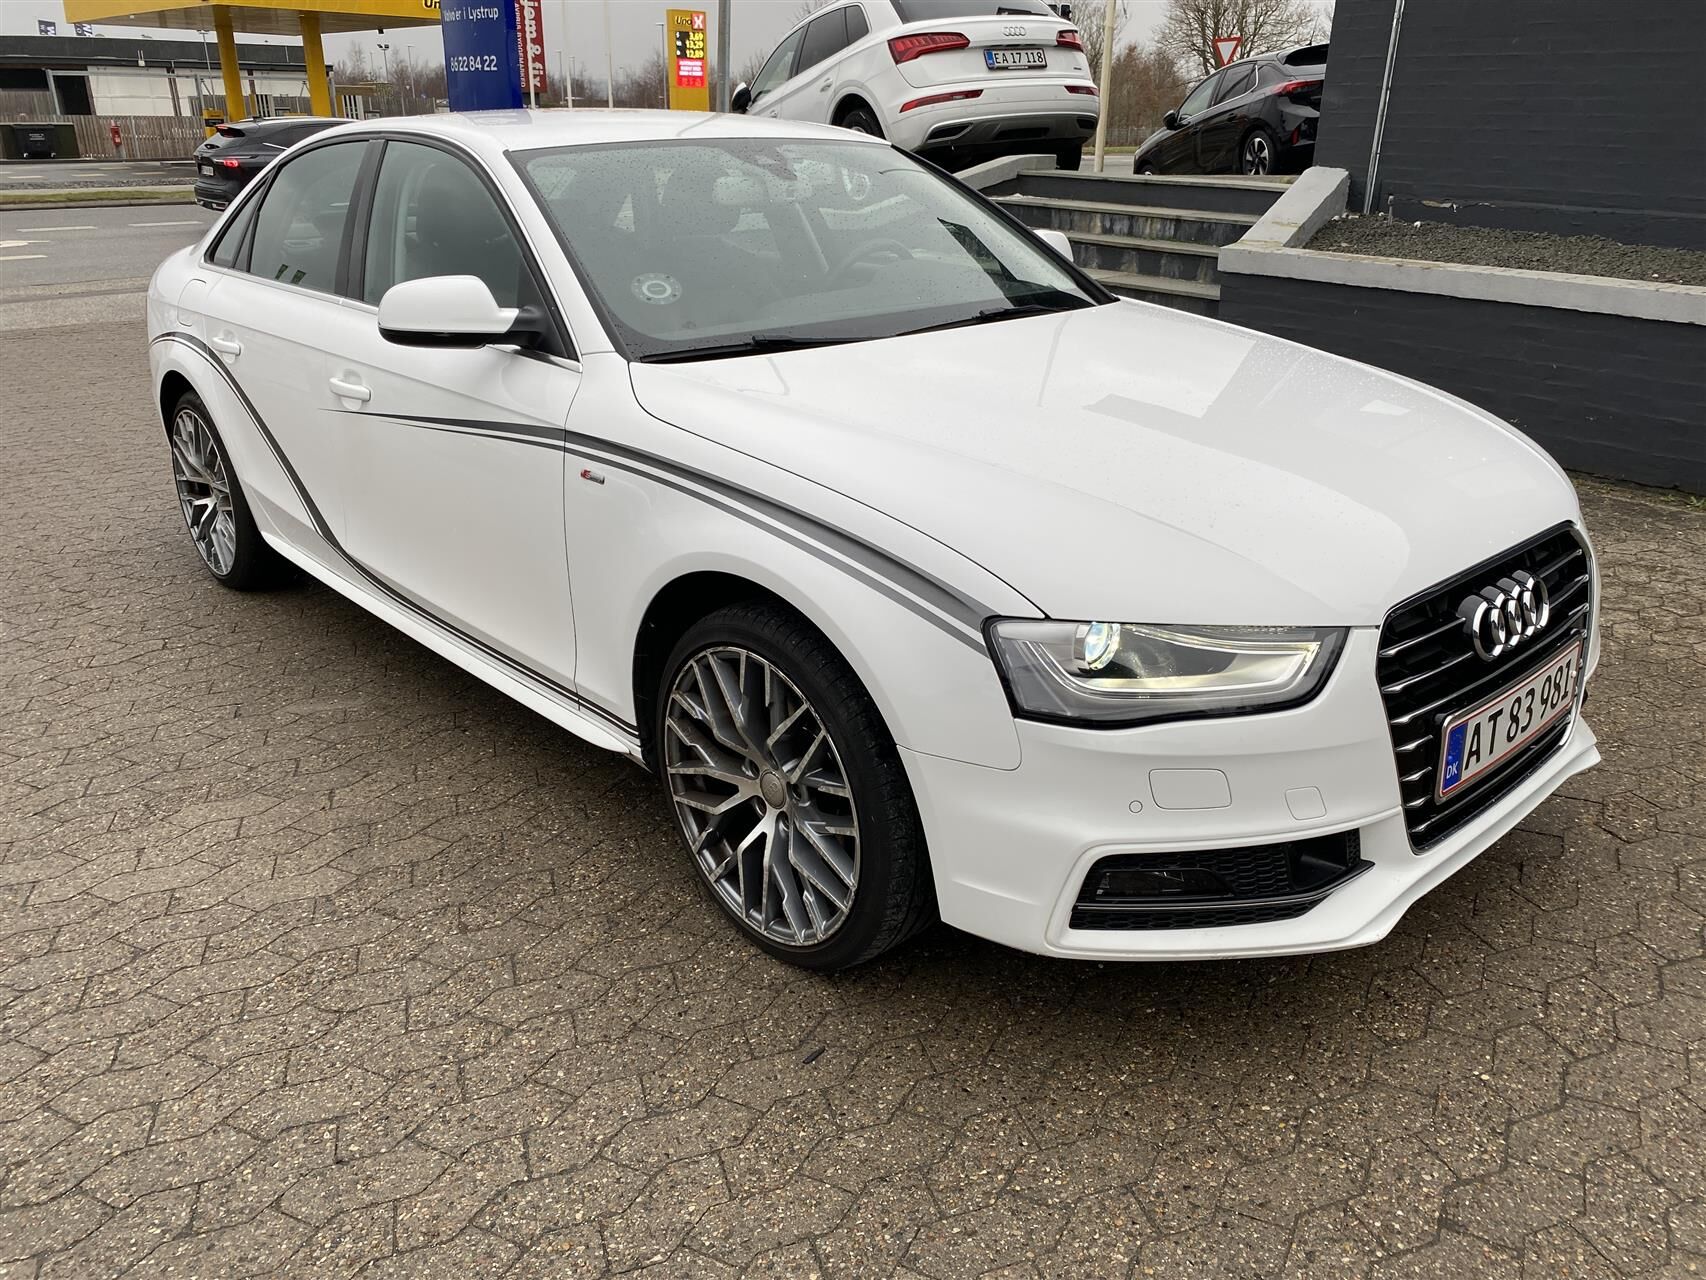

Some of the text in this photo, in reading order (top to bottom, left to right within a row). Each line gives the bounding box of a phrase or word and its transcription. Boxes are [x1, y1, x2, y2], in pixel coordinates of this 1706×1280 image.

[468, 6, 499, 22] Lystrup
[676, 15, 704, 29] Uno X
[528, 43, 541, 58] &
[994, 53, 1009, 64] EA
[1010, 52, 1021, 64] 17
[1025, 52, 1044, 63] 118
[1464, 658, 1571, 771] AT 83 981
[1446, 761, 1459, 779] DK
